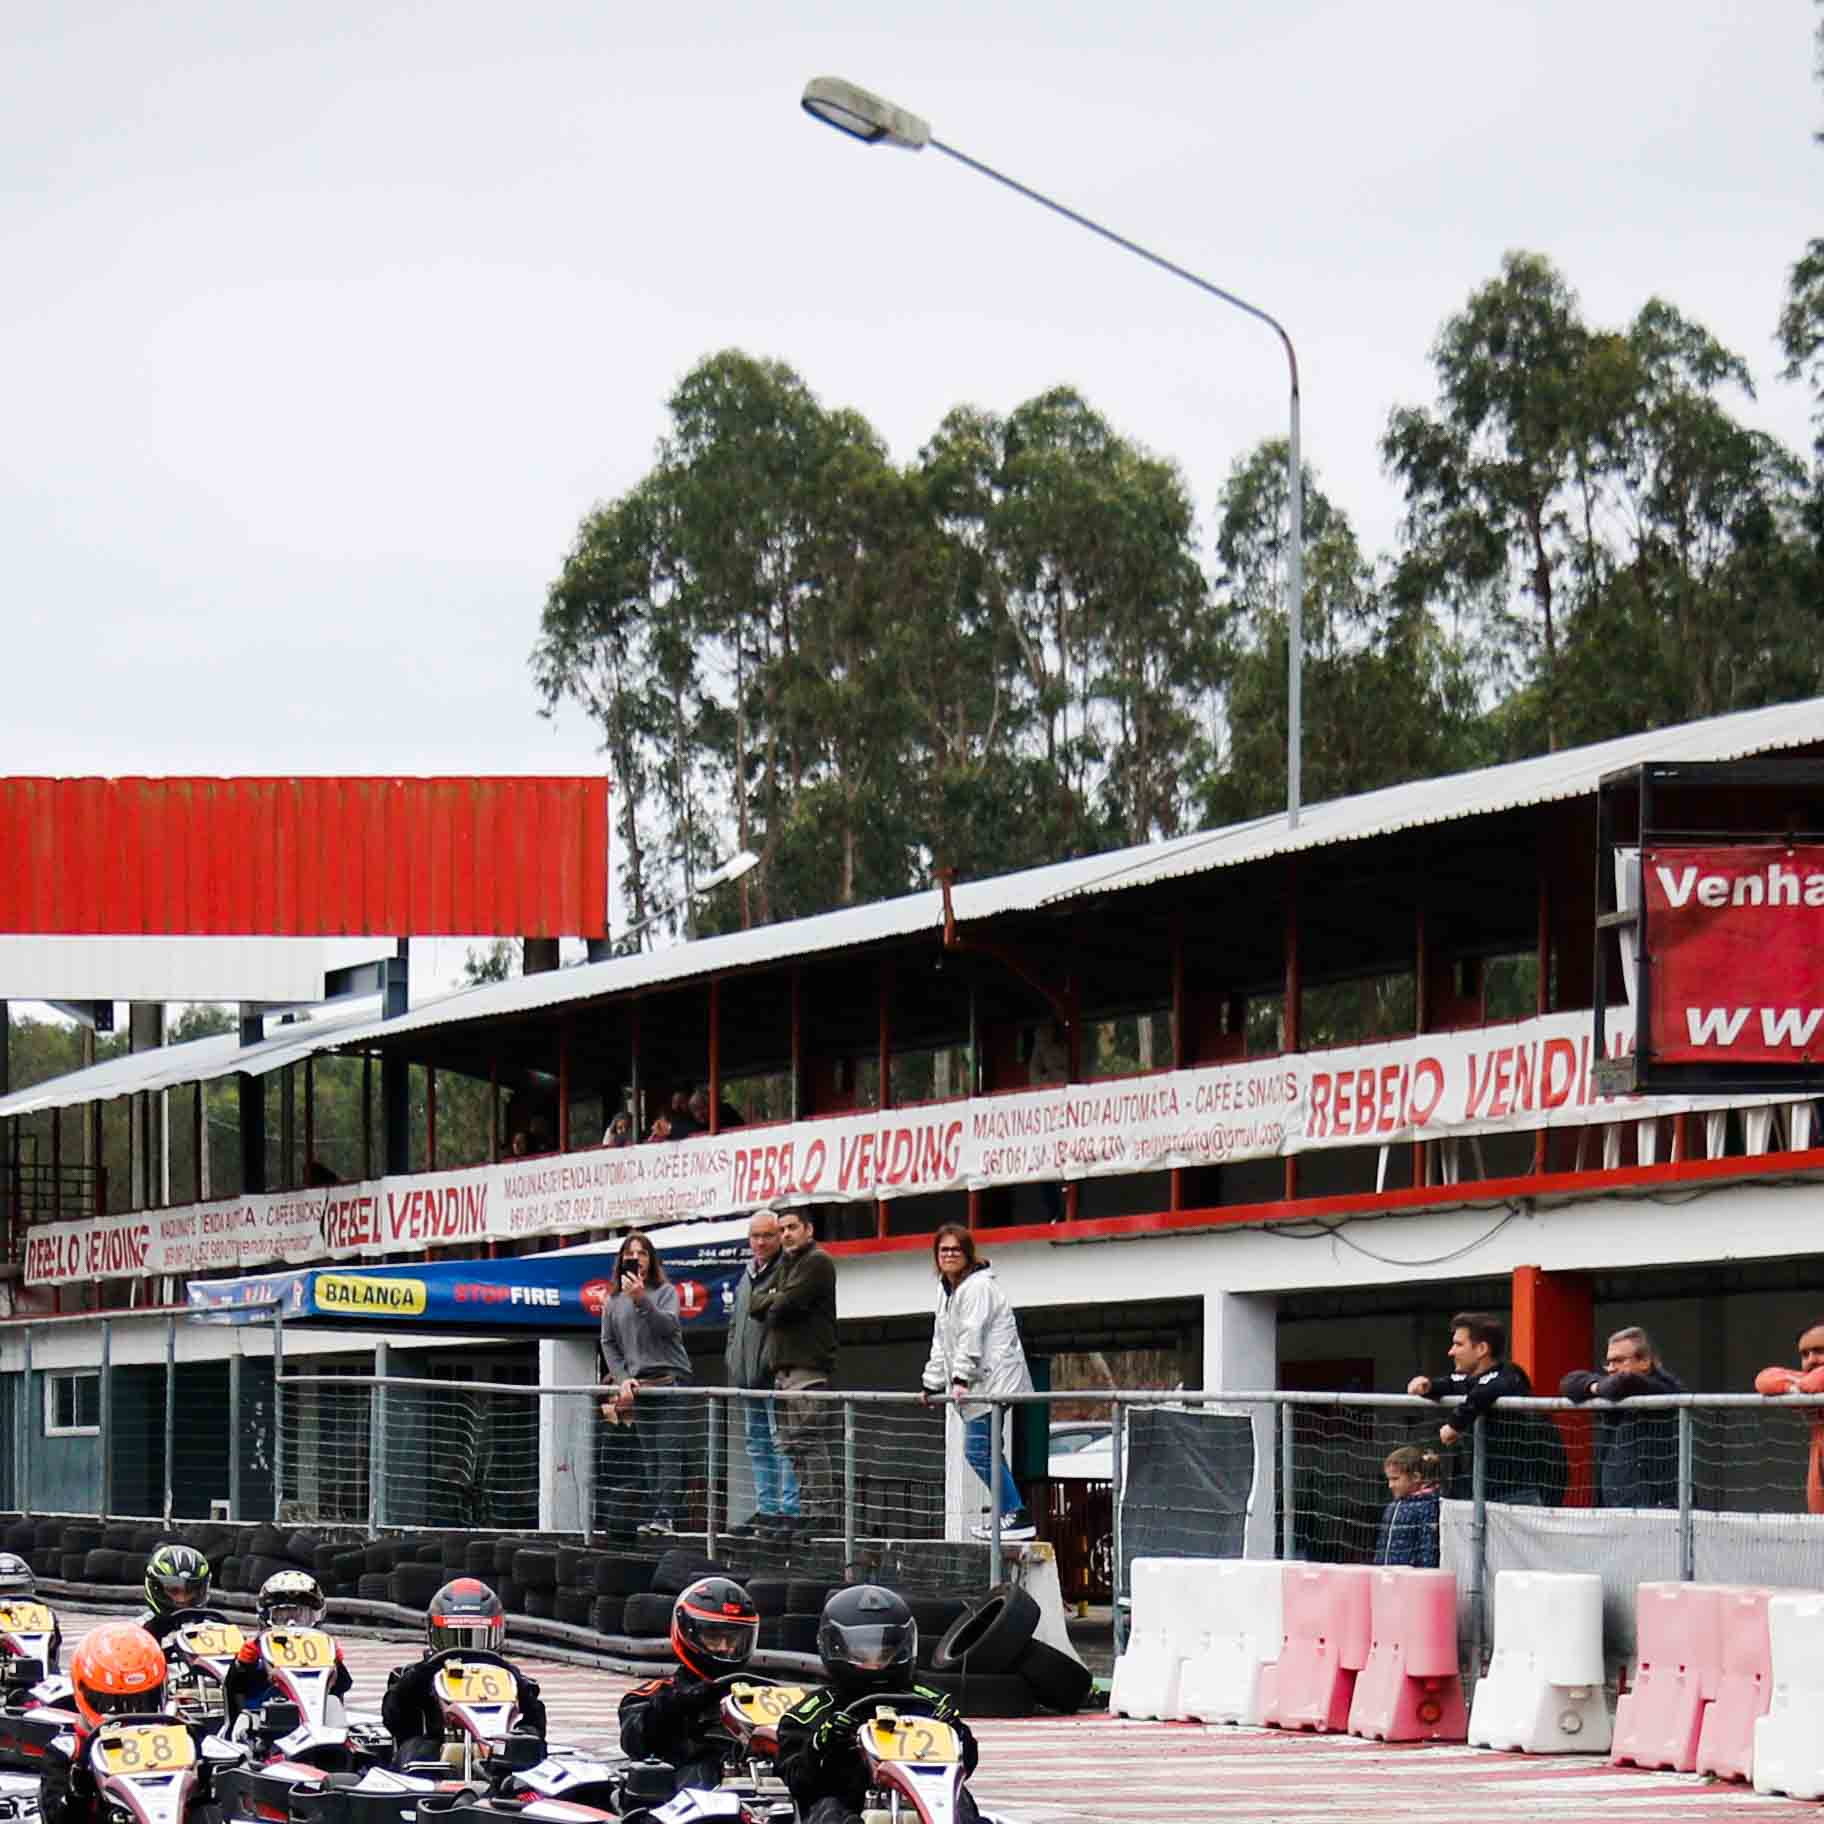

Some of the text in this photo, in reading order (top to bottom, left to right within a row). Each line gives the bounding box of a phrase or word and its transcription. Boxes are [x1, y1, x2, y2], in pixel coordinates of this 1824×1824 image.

[325, 1284, 415, 1309] BALANÇA
[283, 1639, 318, 1663] 80
[463, 1674, 500, 1697] 76
[121, 1734, 173, 1766] 88
[897, 1729, 941, 1757] 72
